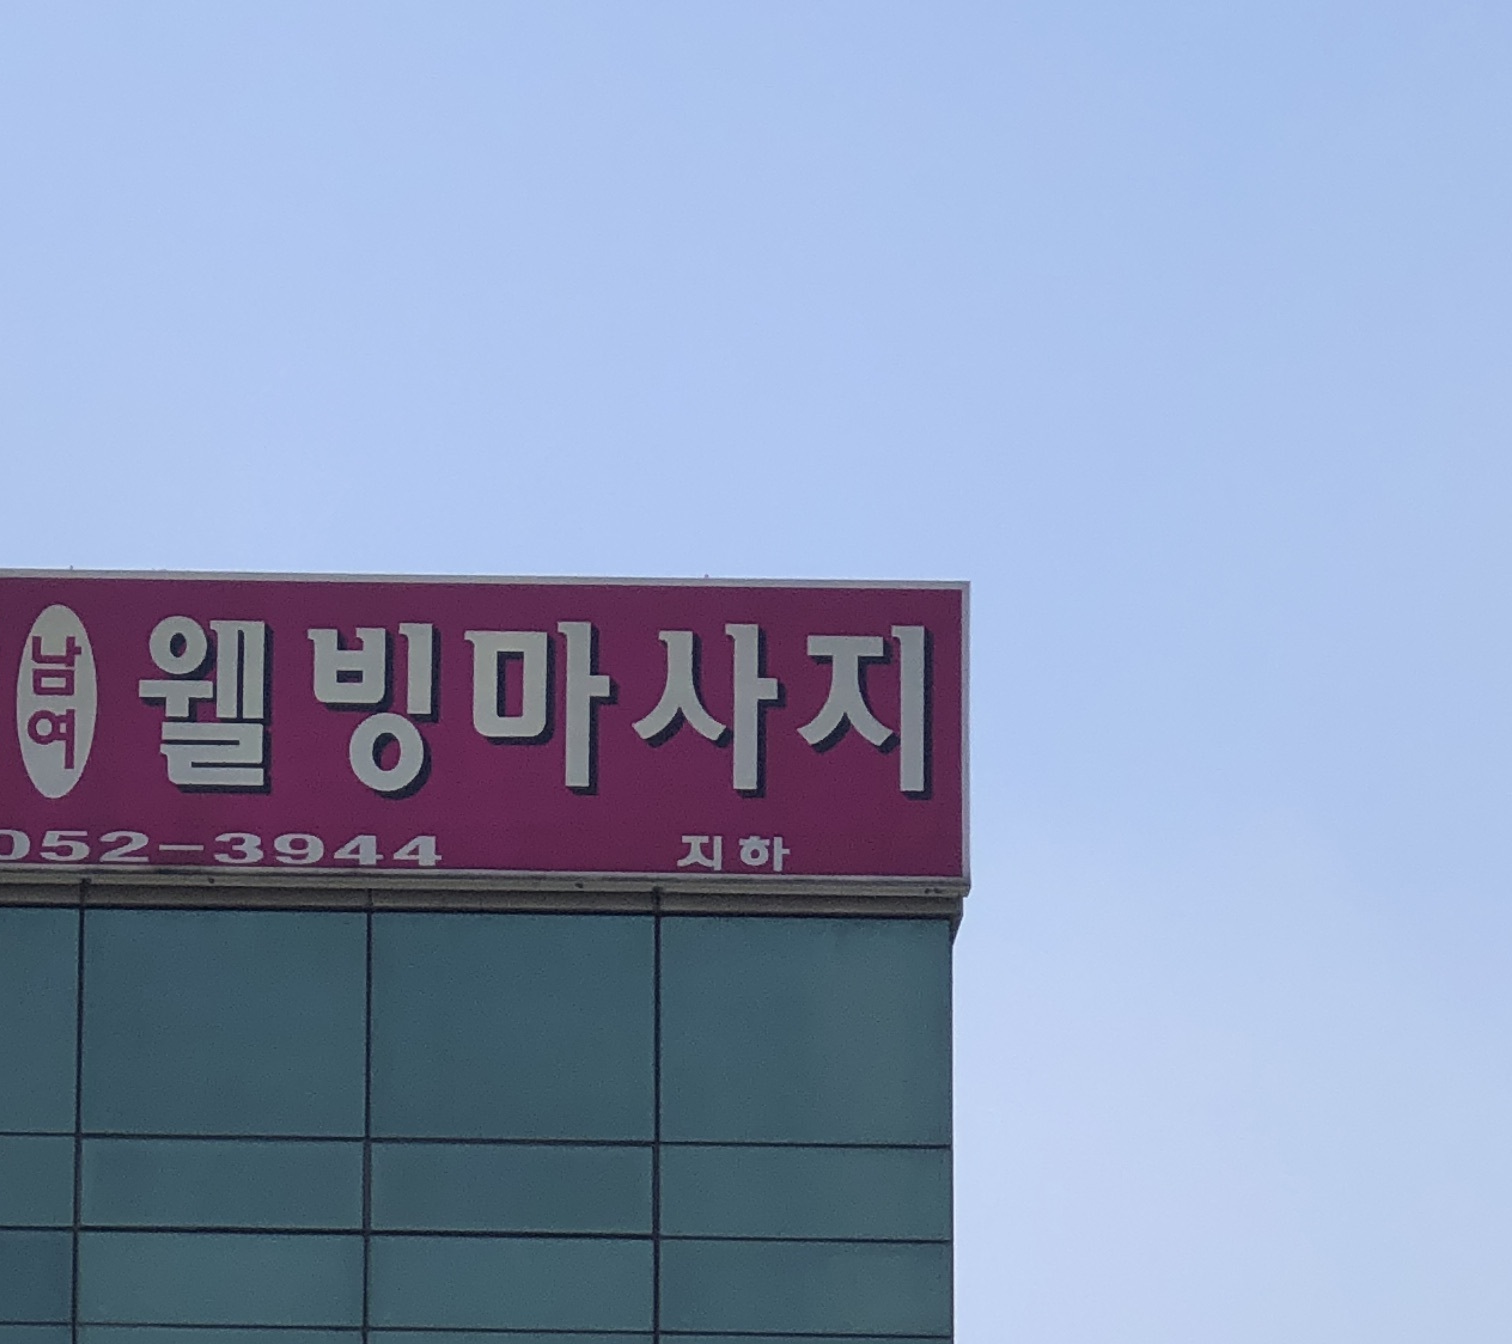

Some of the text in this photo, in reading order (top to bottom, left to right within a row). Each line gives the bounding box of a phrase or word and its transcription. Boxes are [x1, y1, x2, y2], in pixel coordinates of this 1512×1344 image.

[29, 630, 83, 772] 남여
[138, 614, 934, 797] 웰빙마사지
[675, 834, 792, 874] 지하
